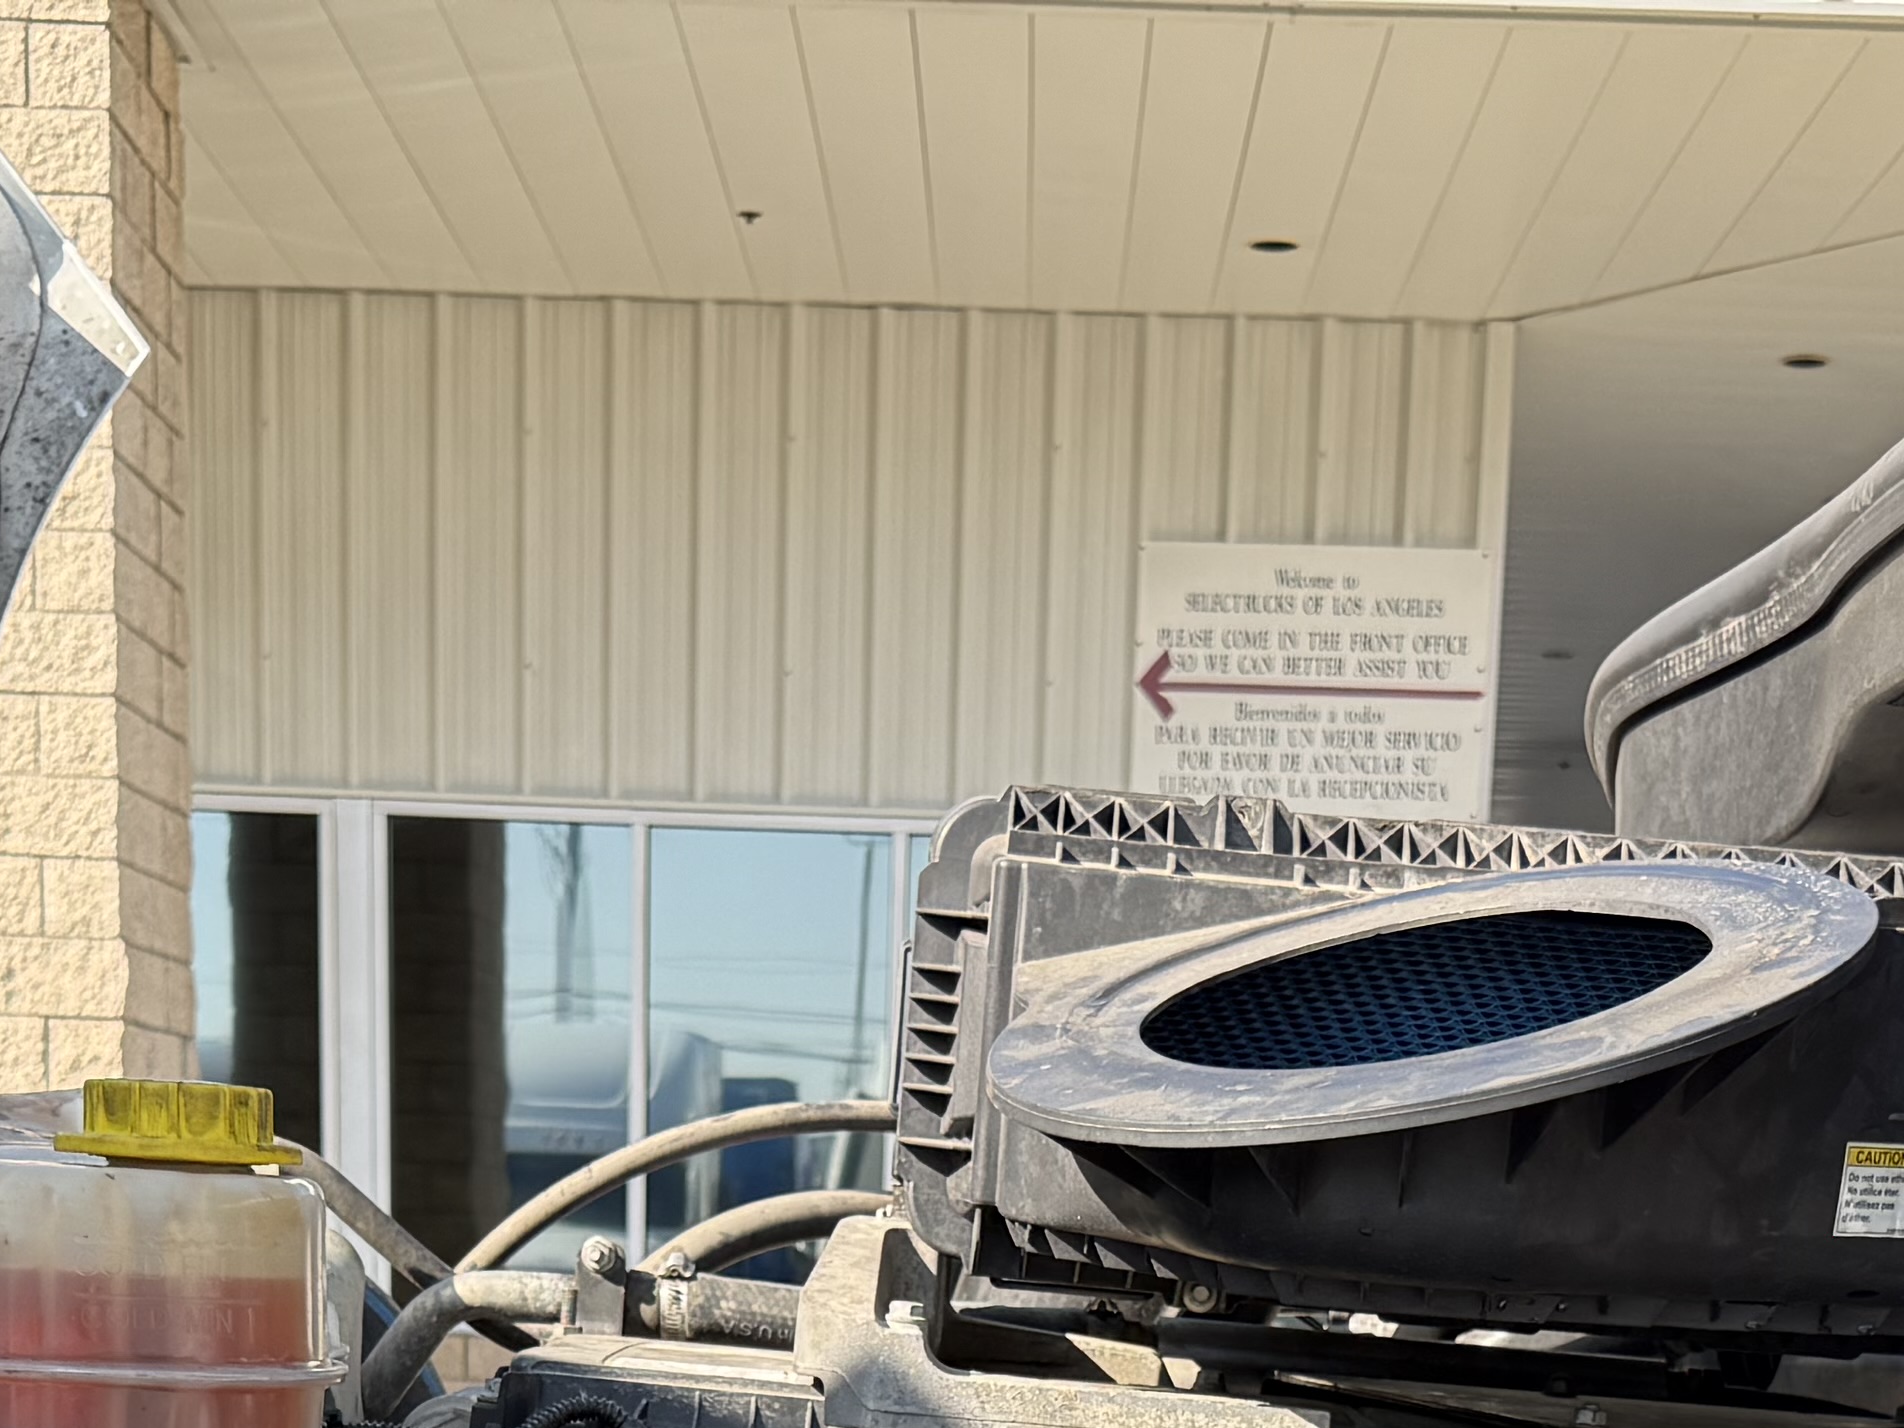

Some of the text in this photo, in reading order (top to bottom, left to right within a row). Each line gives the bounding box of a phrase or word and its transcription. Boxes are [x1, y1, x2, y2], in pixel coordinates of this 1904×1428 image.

[1275, 568, 1360, 589] Welcome to
[1184, 592, 1445, 618] SELECTRUCKS OF LOS ANGELES
[1157, 628, 1469, 655] PLEASE COME IN THE FRONT OFFICE
[1174, 654, 1451, 680] SO WE CAN BETTER ASSIST YOU
[1154, 725, 1201, 745] PARA
[1287, 728, 1315, 748] UN
[1322, 728, 1377, 751] MEJOR
[1384, 731, 1461, 752] SERVICIO
[1177, 750, 1437, 777] POR FAVOR DE ANUNCIAR SU
[1158, 775, 1449, 802] LLEGADA CON LA RECEPCIONISTA
[1848, 1172, 1859, 1182] Do
[1861, 1173, 1874, 1183] not
